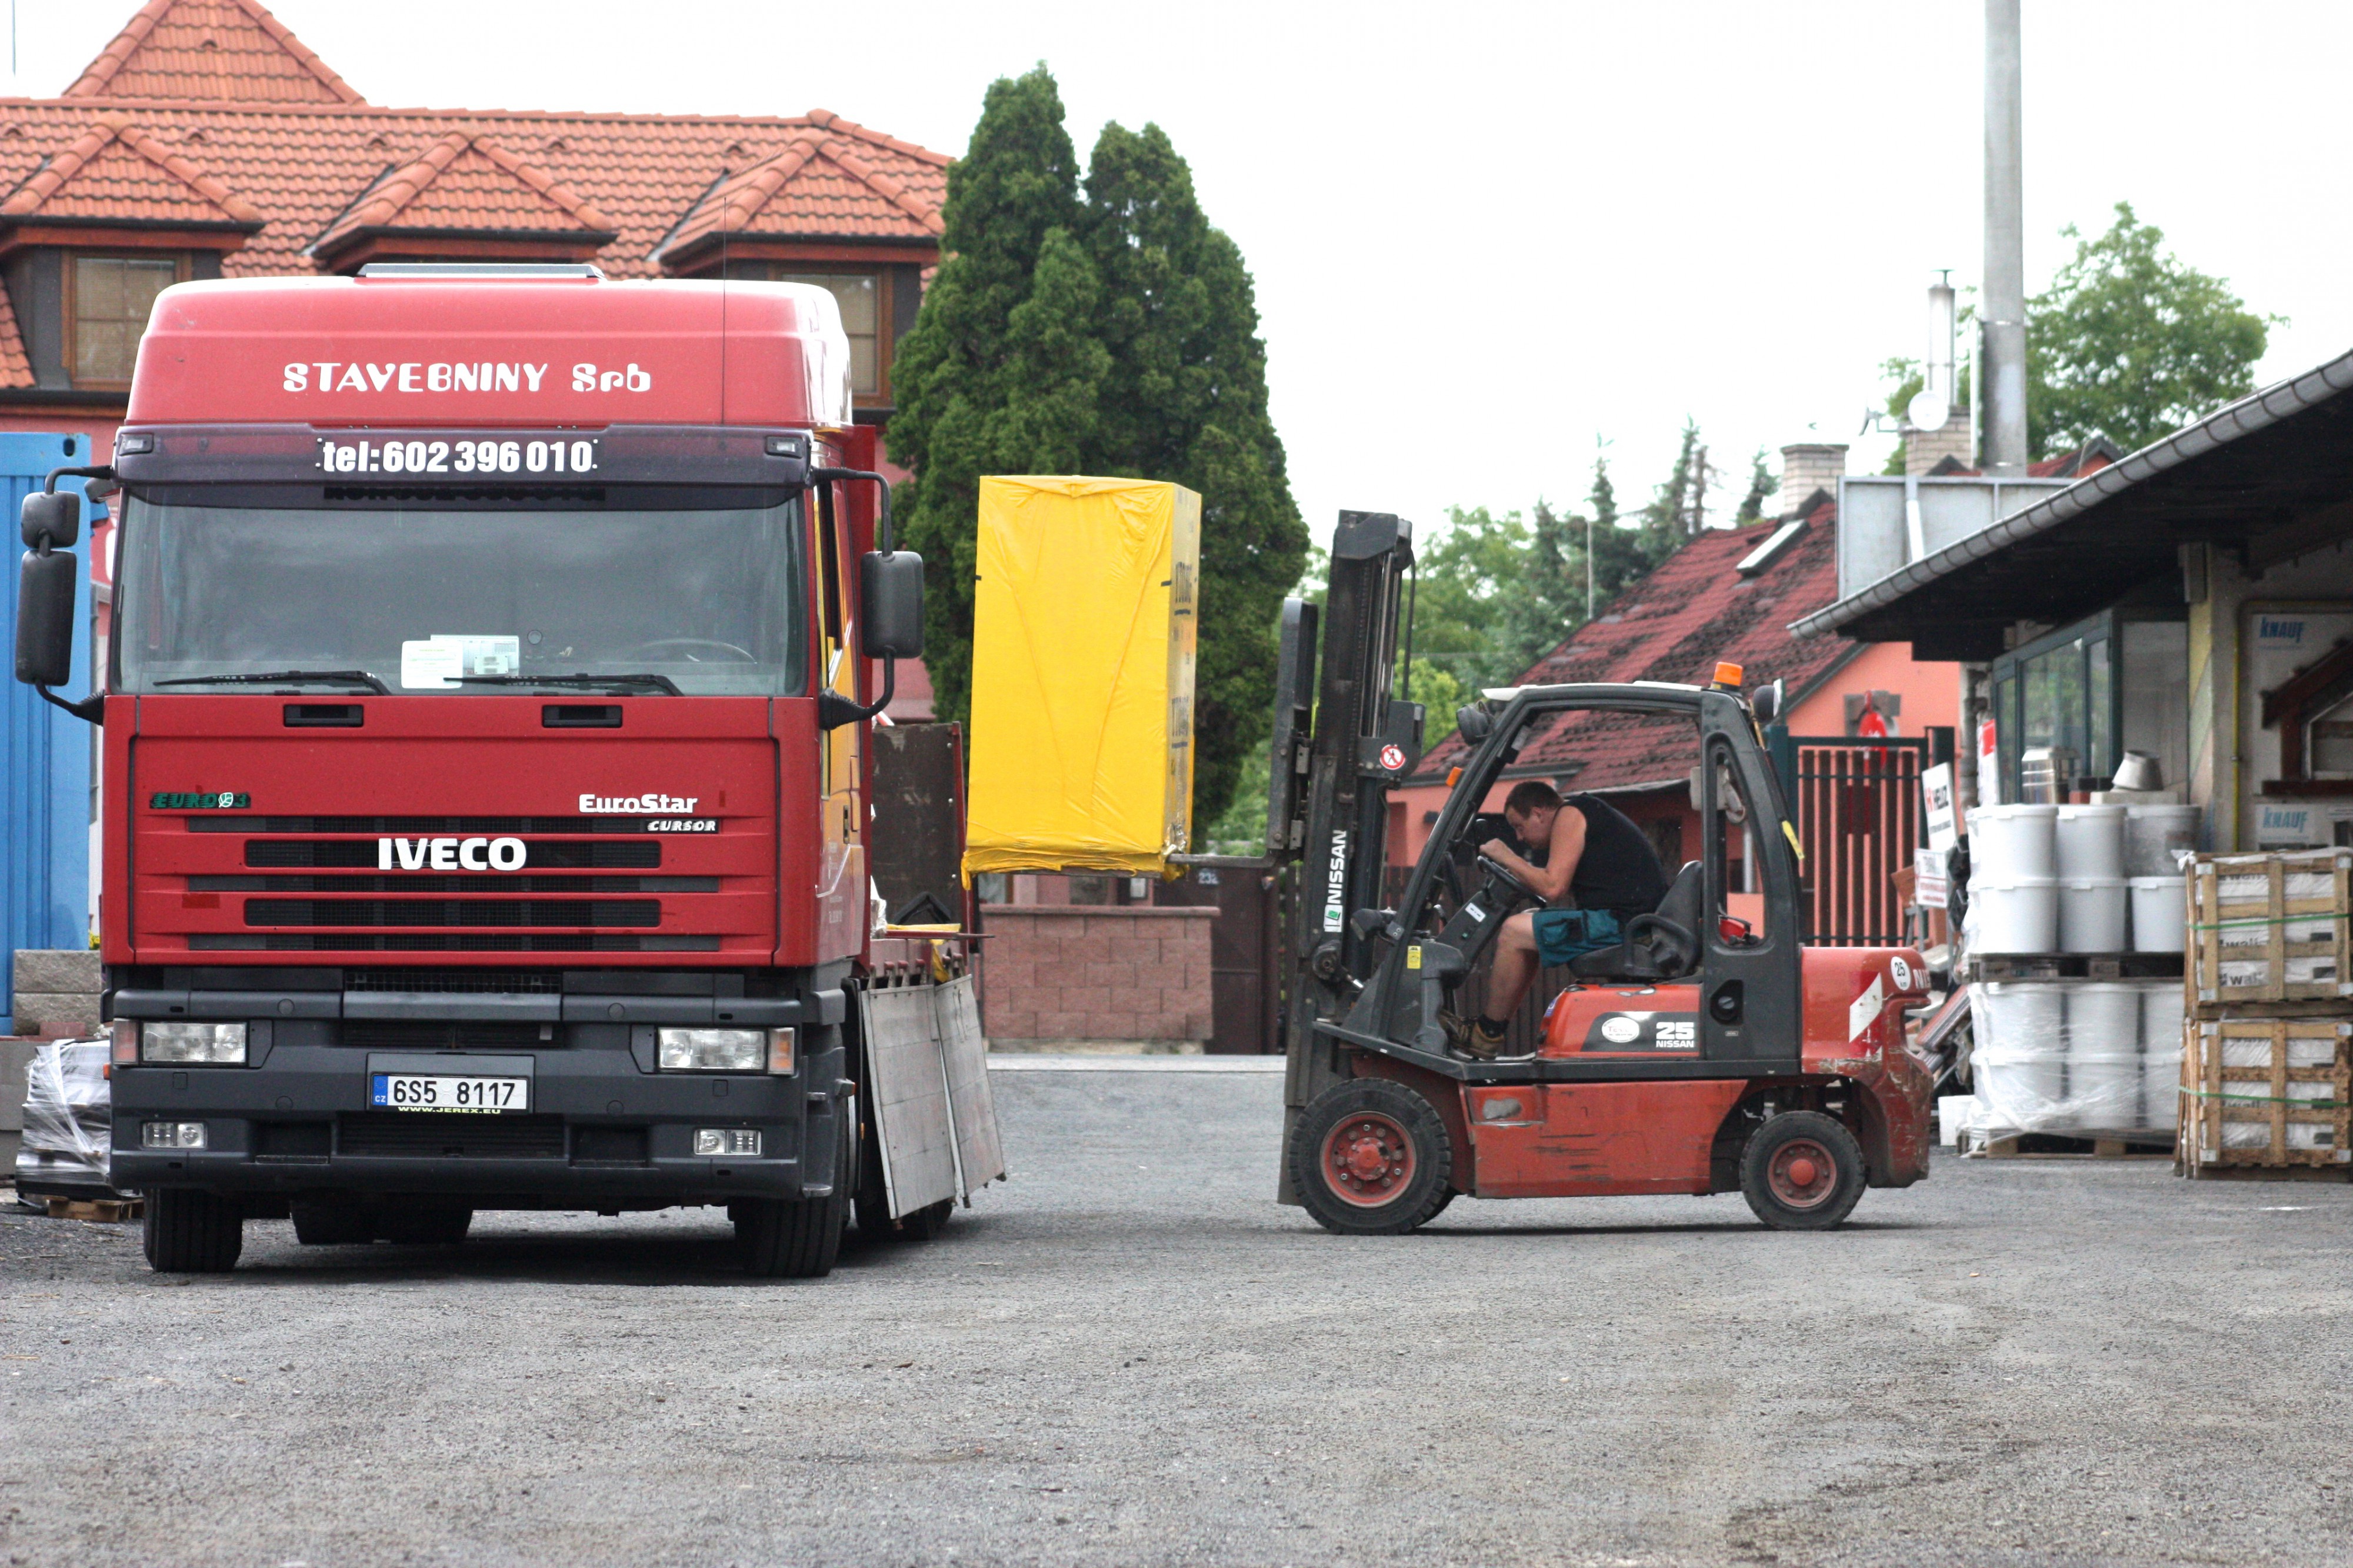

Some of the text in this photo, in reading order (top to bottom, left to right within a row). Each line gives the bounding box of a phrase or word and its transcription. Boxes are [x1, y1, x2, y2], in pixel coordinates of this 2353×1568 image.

[283, 362, 651, 392] STAVEBNINY Srb
[455, 441, 520, 472] 396
[152, 792, 248, 808] EURO 3
[579, 794, 698, 813] EuroStar
[647, 820, 716, 832] CURSOR
[378, 837, 526, 871] IVECO
[1327, 829, 1347, 905] NISSAN
[1894, 962, 1906, 977] 25
[1656, 1022, 1695, 1040] 25
[1655, 1040, 1695, 1048] NISSAN
[375, 1095, 386, 1103] CZ
[394, 1079, 515, 1106] 6S5 8117
[398, 1105, 501, 1115] WWW.JEREX.EU
